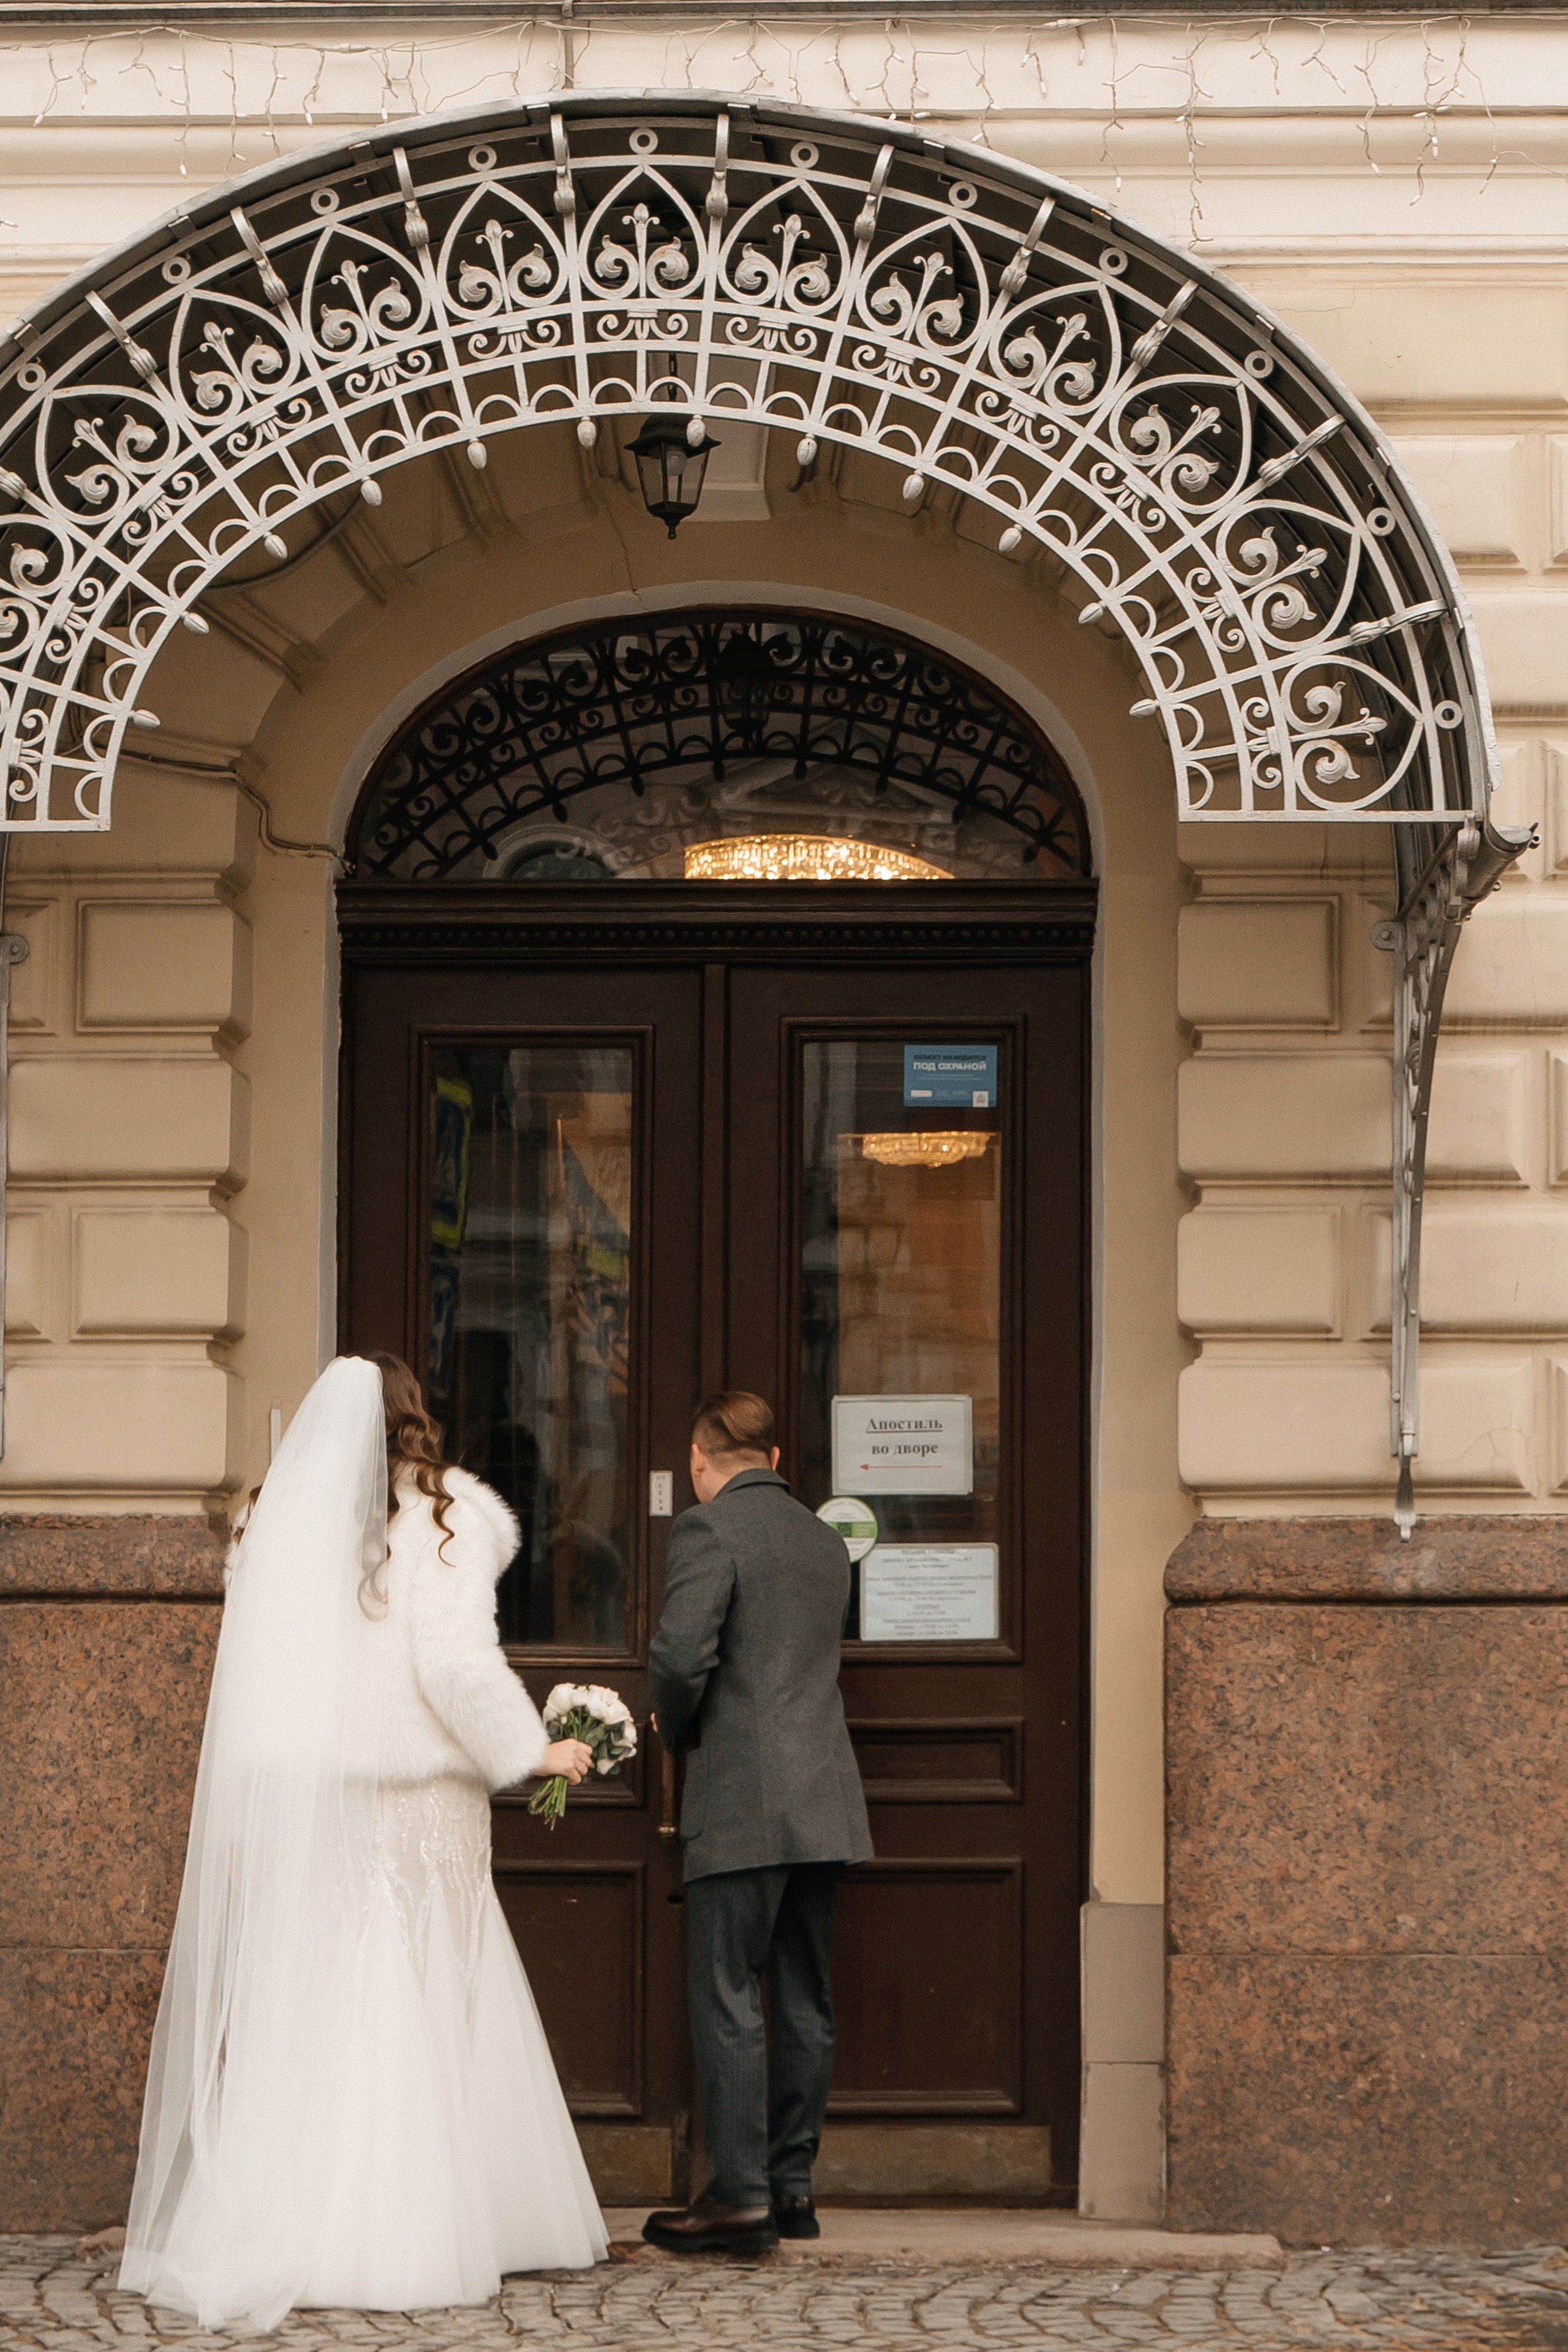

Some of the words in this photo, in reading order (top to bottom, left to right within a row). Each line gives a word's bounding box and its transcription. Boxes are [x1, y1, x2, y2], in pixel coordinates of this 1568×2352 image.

[913, 1062, 936, 1071] ПОД
[938, 1061, 987, 1071] ОХРАНОЙ
[866, 1418, 943, 1430] Апостиль
[872, 1445, 889, 1454] во
[894, 1444, 938, 1457] дворе
